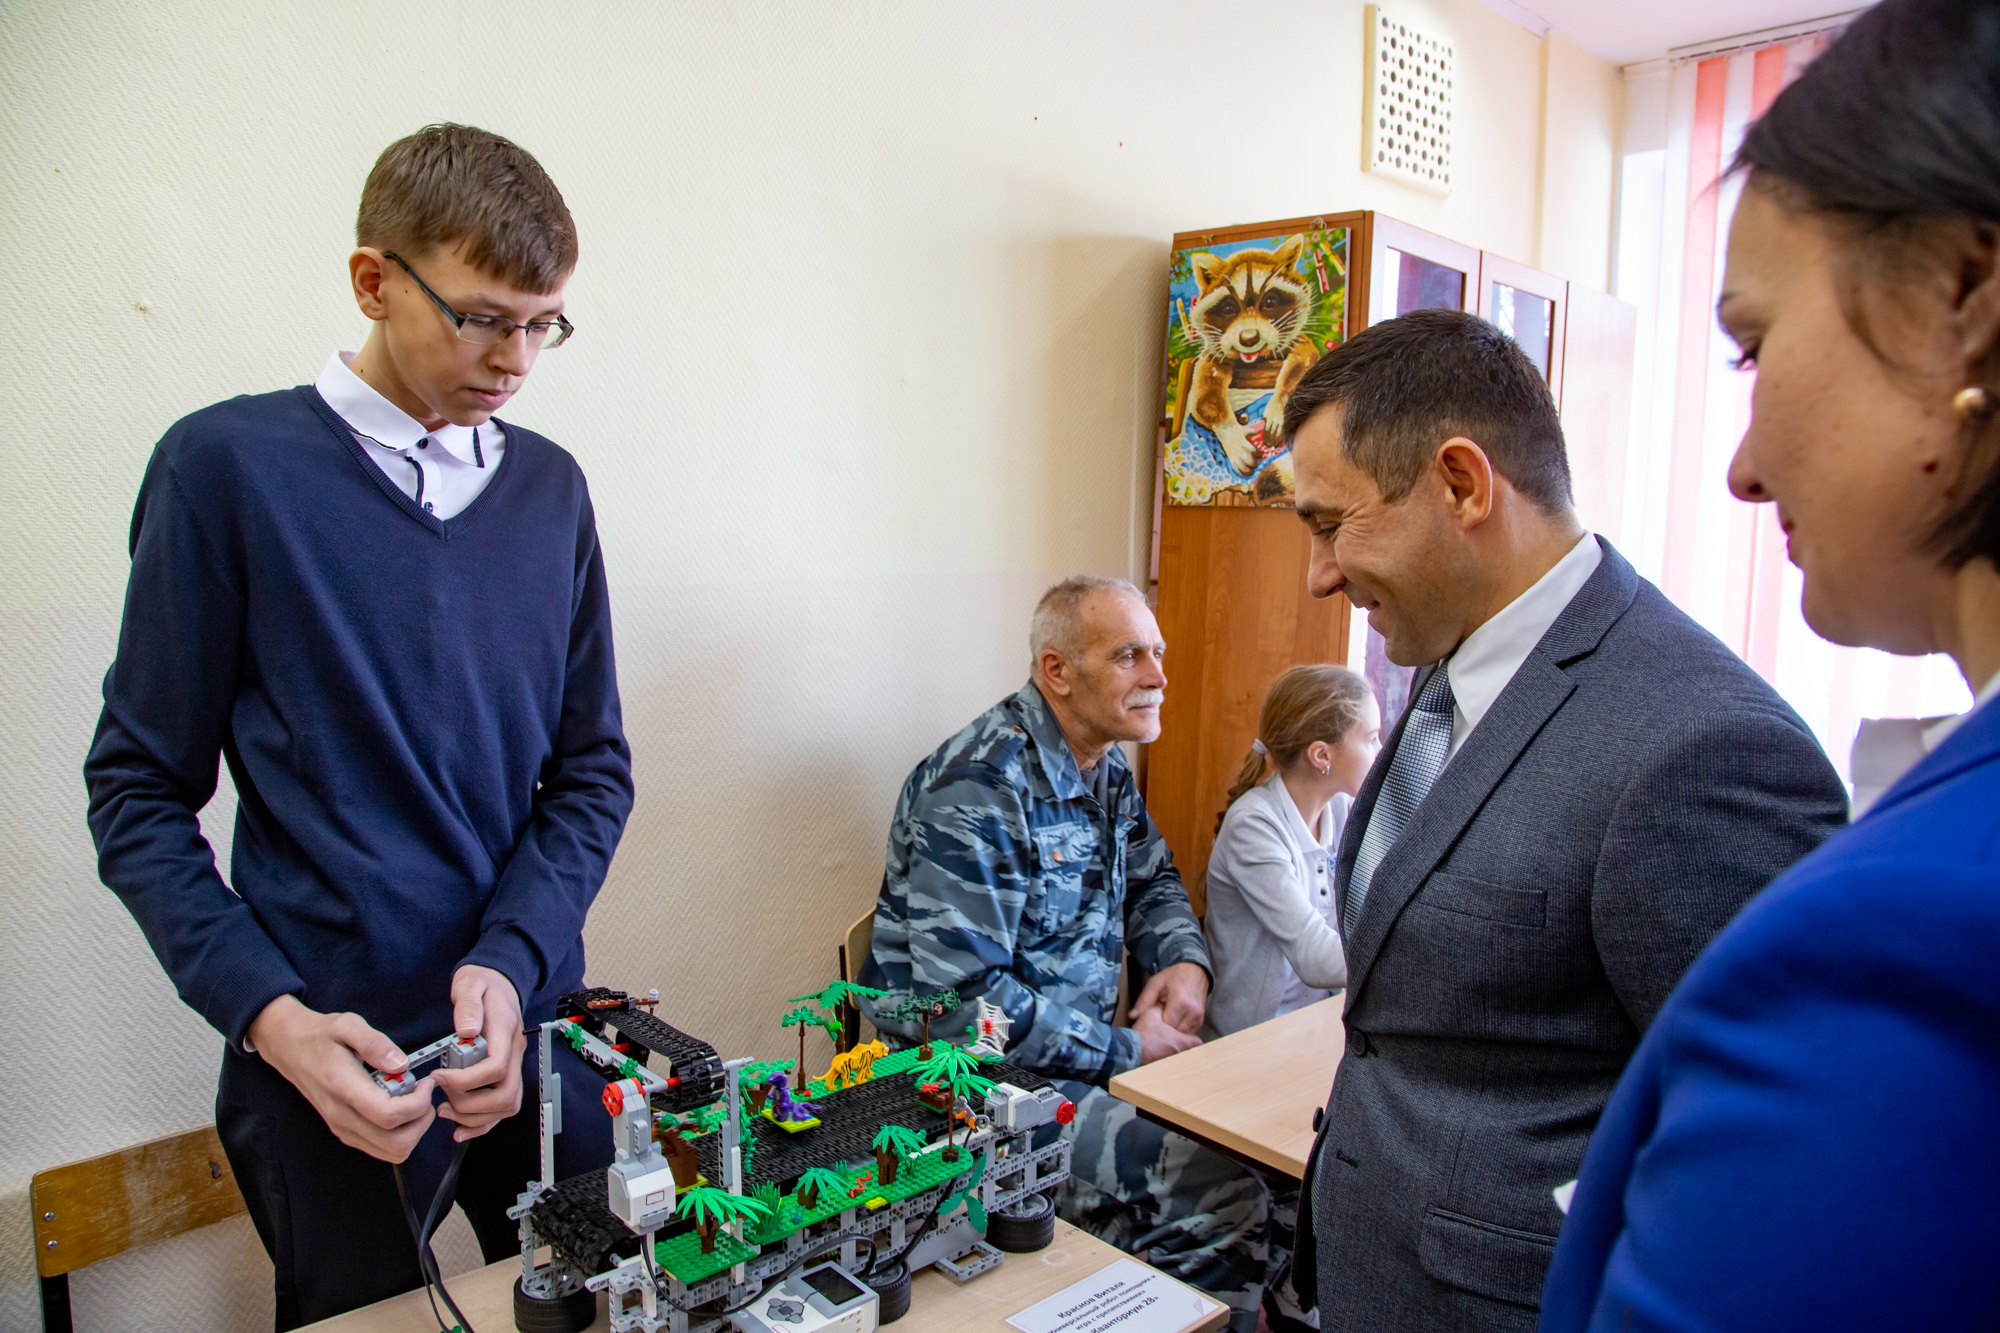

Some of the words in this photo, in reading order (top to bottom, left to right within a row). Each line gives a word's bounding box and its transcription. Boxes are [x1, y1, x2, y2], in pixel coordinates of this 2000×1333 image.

[1057, 1297, 1096, 1319] Краснов
[1093, 1281, 1126, 1299] Виталя
[1100, 1295, 1119, 1308] робот
[1118, 1277, 1152, 1297] помощник
[1075, 1320, 1092, 1331] игра
[1089, 1304, 1145, 1333] Кванториум
